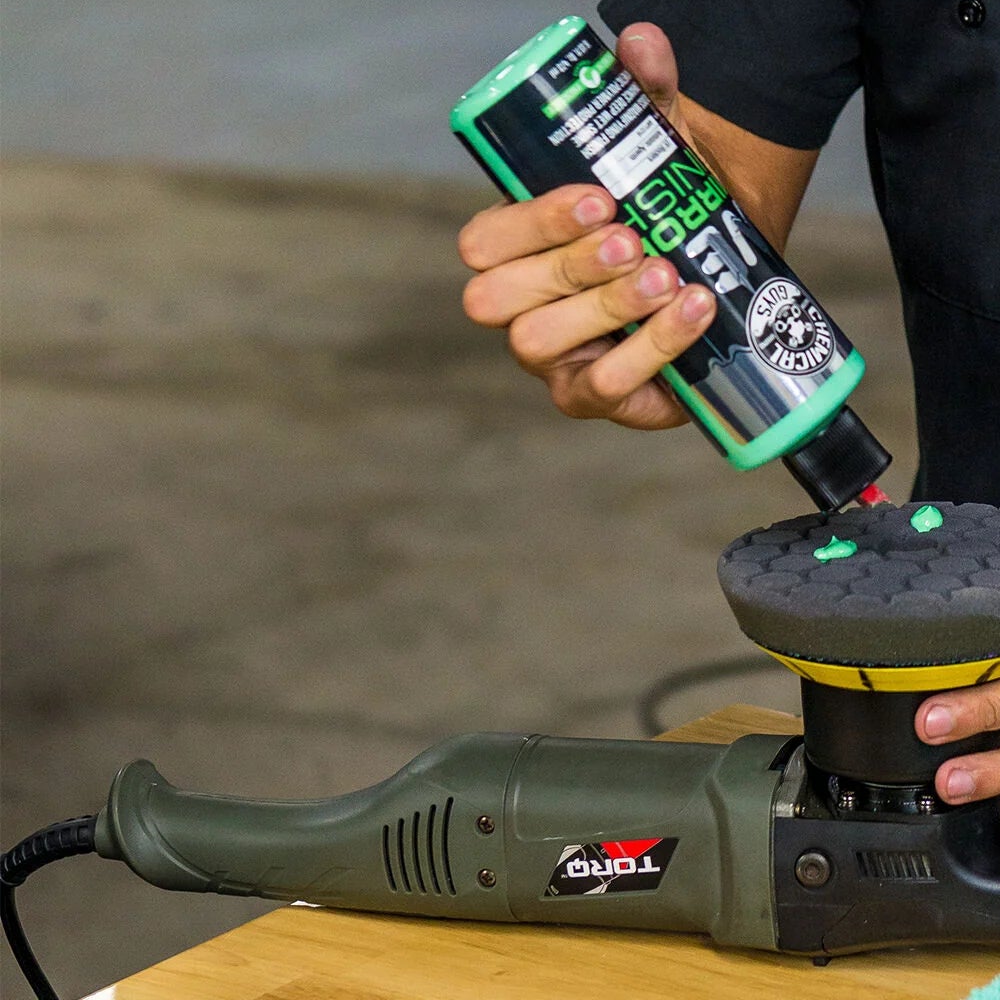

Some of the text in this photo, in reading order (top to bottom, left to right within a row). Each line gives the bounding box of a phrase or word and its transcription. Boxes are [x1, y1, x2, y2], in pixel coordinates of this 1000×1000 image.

[756, 285, 788, 317] GUYS
[769, 305, 831, 371] CHEMICAL
[566, 856, 661, 878] TORQ
